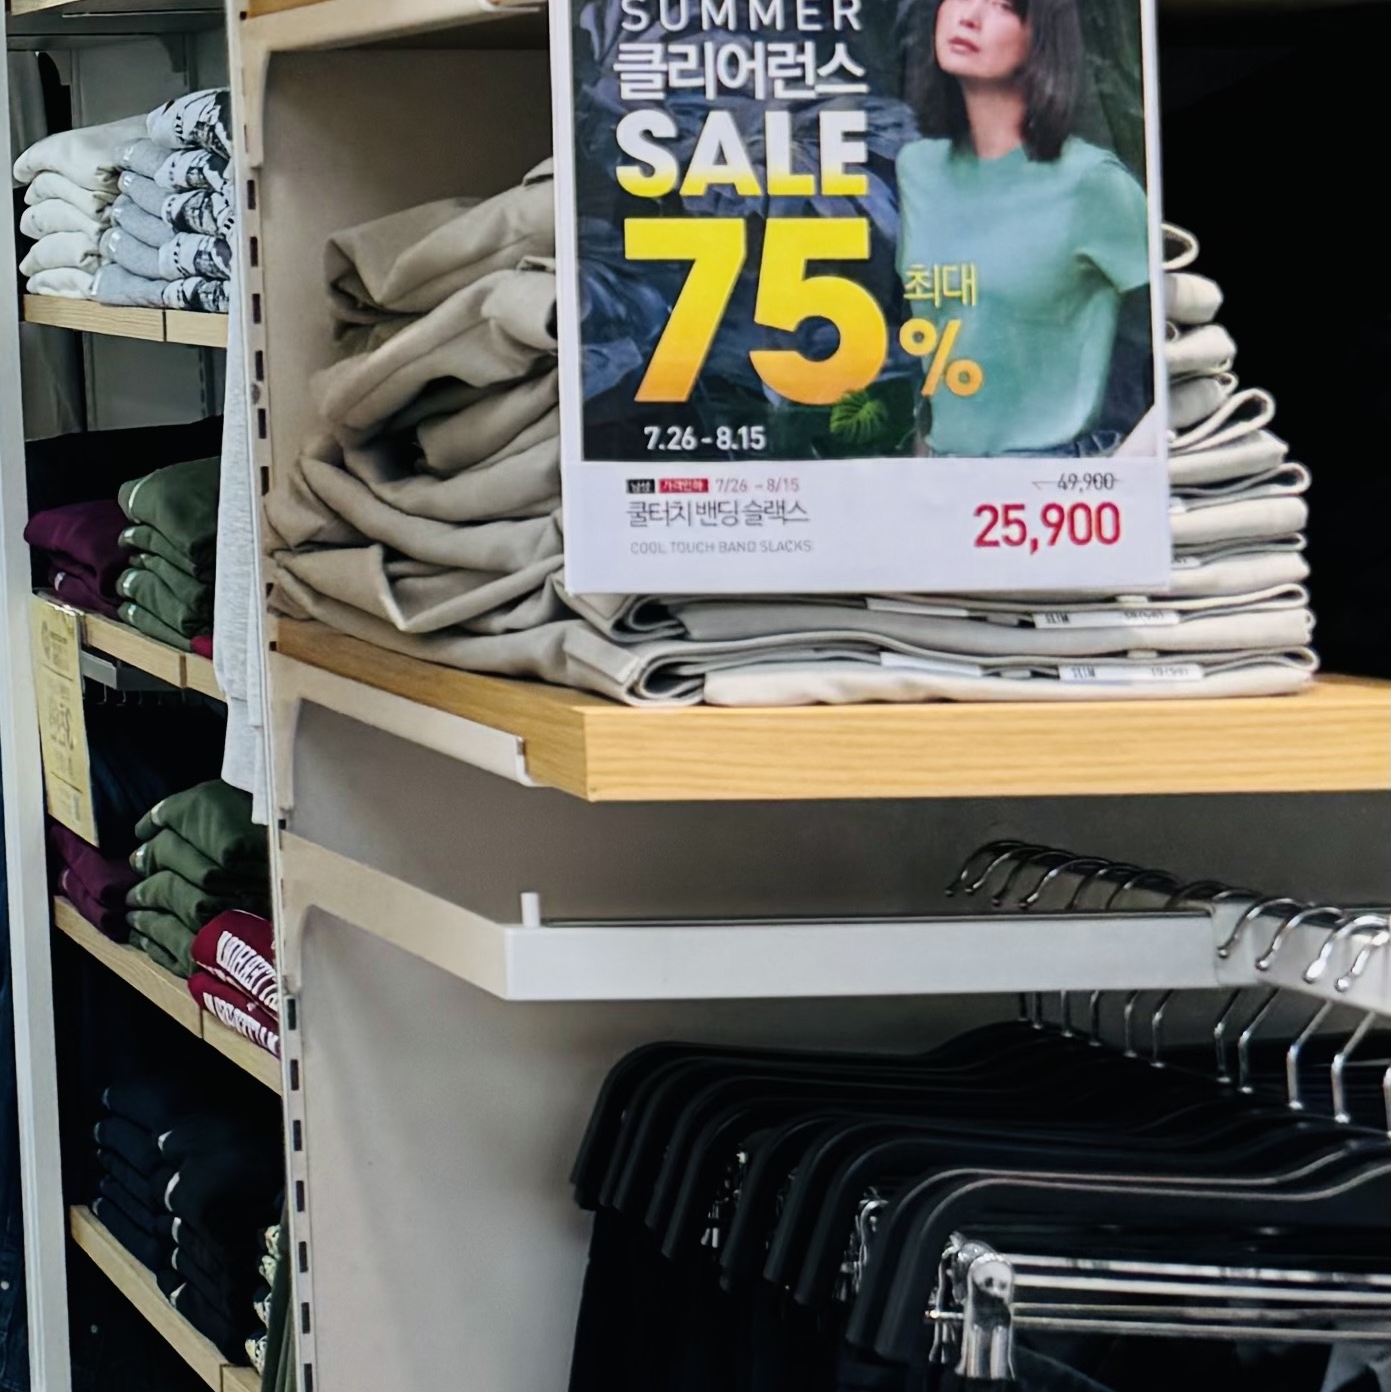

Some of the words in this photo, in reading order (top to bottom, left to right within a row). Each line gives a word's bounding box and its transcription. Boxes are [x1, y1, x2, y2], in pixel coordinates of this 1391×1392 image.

[612, 39, 870, 101] 클리어런스
[615, 110, 870, 198] SALE
[903, 263, 978, 308] 최대
[630, 541, 667, 555] COOL
[671, 541, 716, 554] TOUCH
[719, 540, 757, 554] BAND
[760, 539, 813, 553] SLACKS
[973, 501, 1121, 556] 25,900
